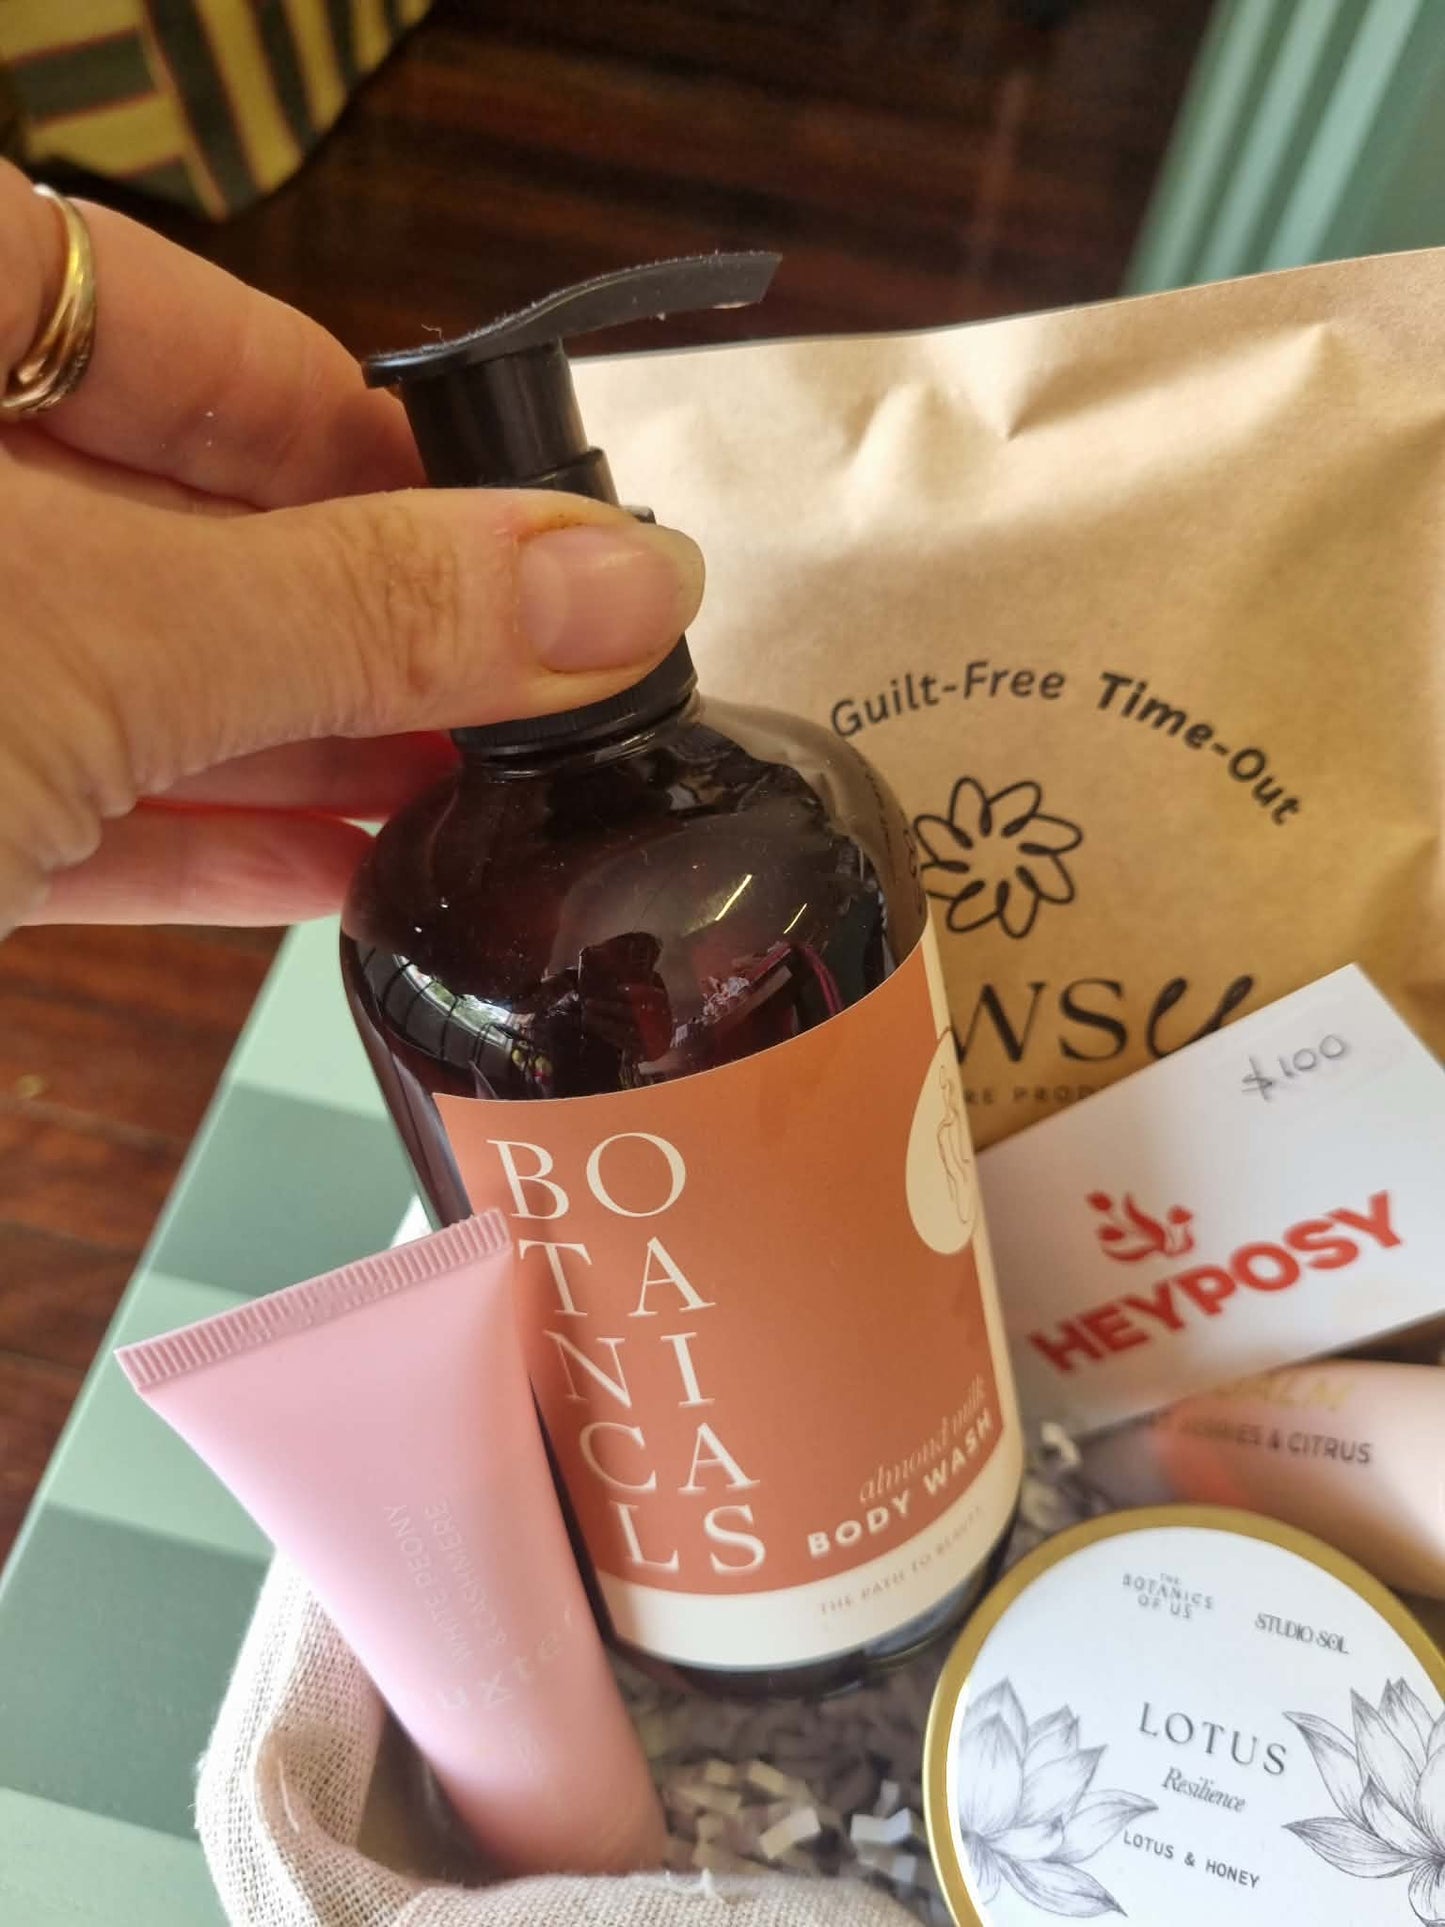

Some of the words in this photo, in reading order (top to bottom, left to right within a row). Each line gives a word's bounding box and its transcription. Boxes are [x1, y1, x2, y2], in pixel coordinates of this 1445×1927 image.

[831, 660, 1066, 738] Guilt-Free
[1096, 671, 1300, 826] Time-Out
[1013, 1083, 1099, 1105] PROD
[1240, 1034, 1346, 1102] $100
[1028, 1189, 1403, 1374] HEYPOSY
[1286, 1430, 1373, 1465] CITRUS
[807, 1488, 910, 1559] BODY
[922, 1406, 994, 1497] WASH
[383, 1503, 433, 1589] PEONY
[1122, 1573, 1214, 1610] BOTANICS
[1137, 1594, 1161, 1610] OF
[1169, 1601, 1192, 1620] US
[1254, 1611, 1314, 1643] STUDIO
[1315, 1630, 1350, 1656] SOL
[1138, 1701, 1288, 1776] LOTUS
[1161, 1765, 1247, 1813] Resilience
[1123, 1829, 1175, 1860] LOTUS
[1183, 1850, 1197, 1868] &
[1204, 1858, 1261, 1889] HONEY
